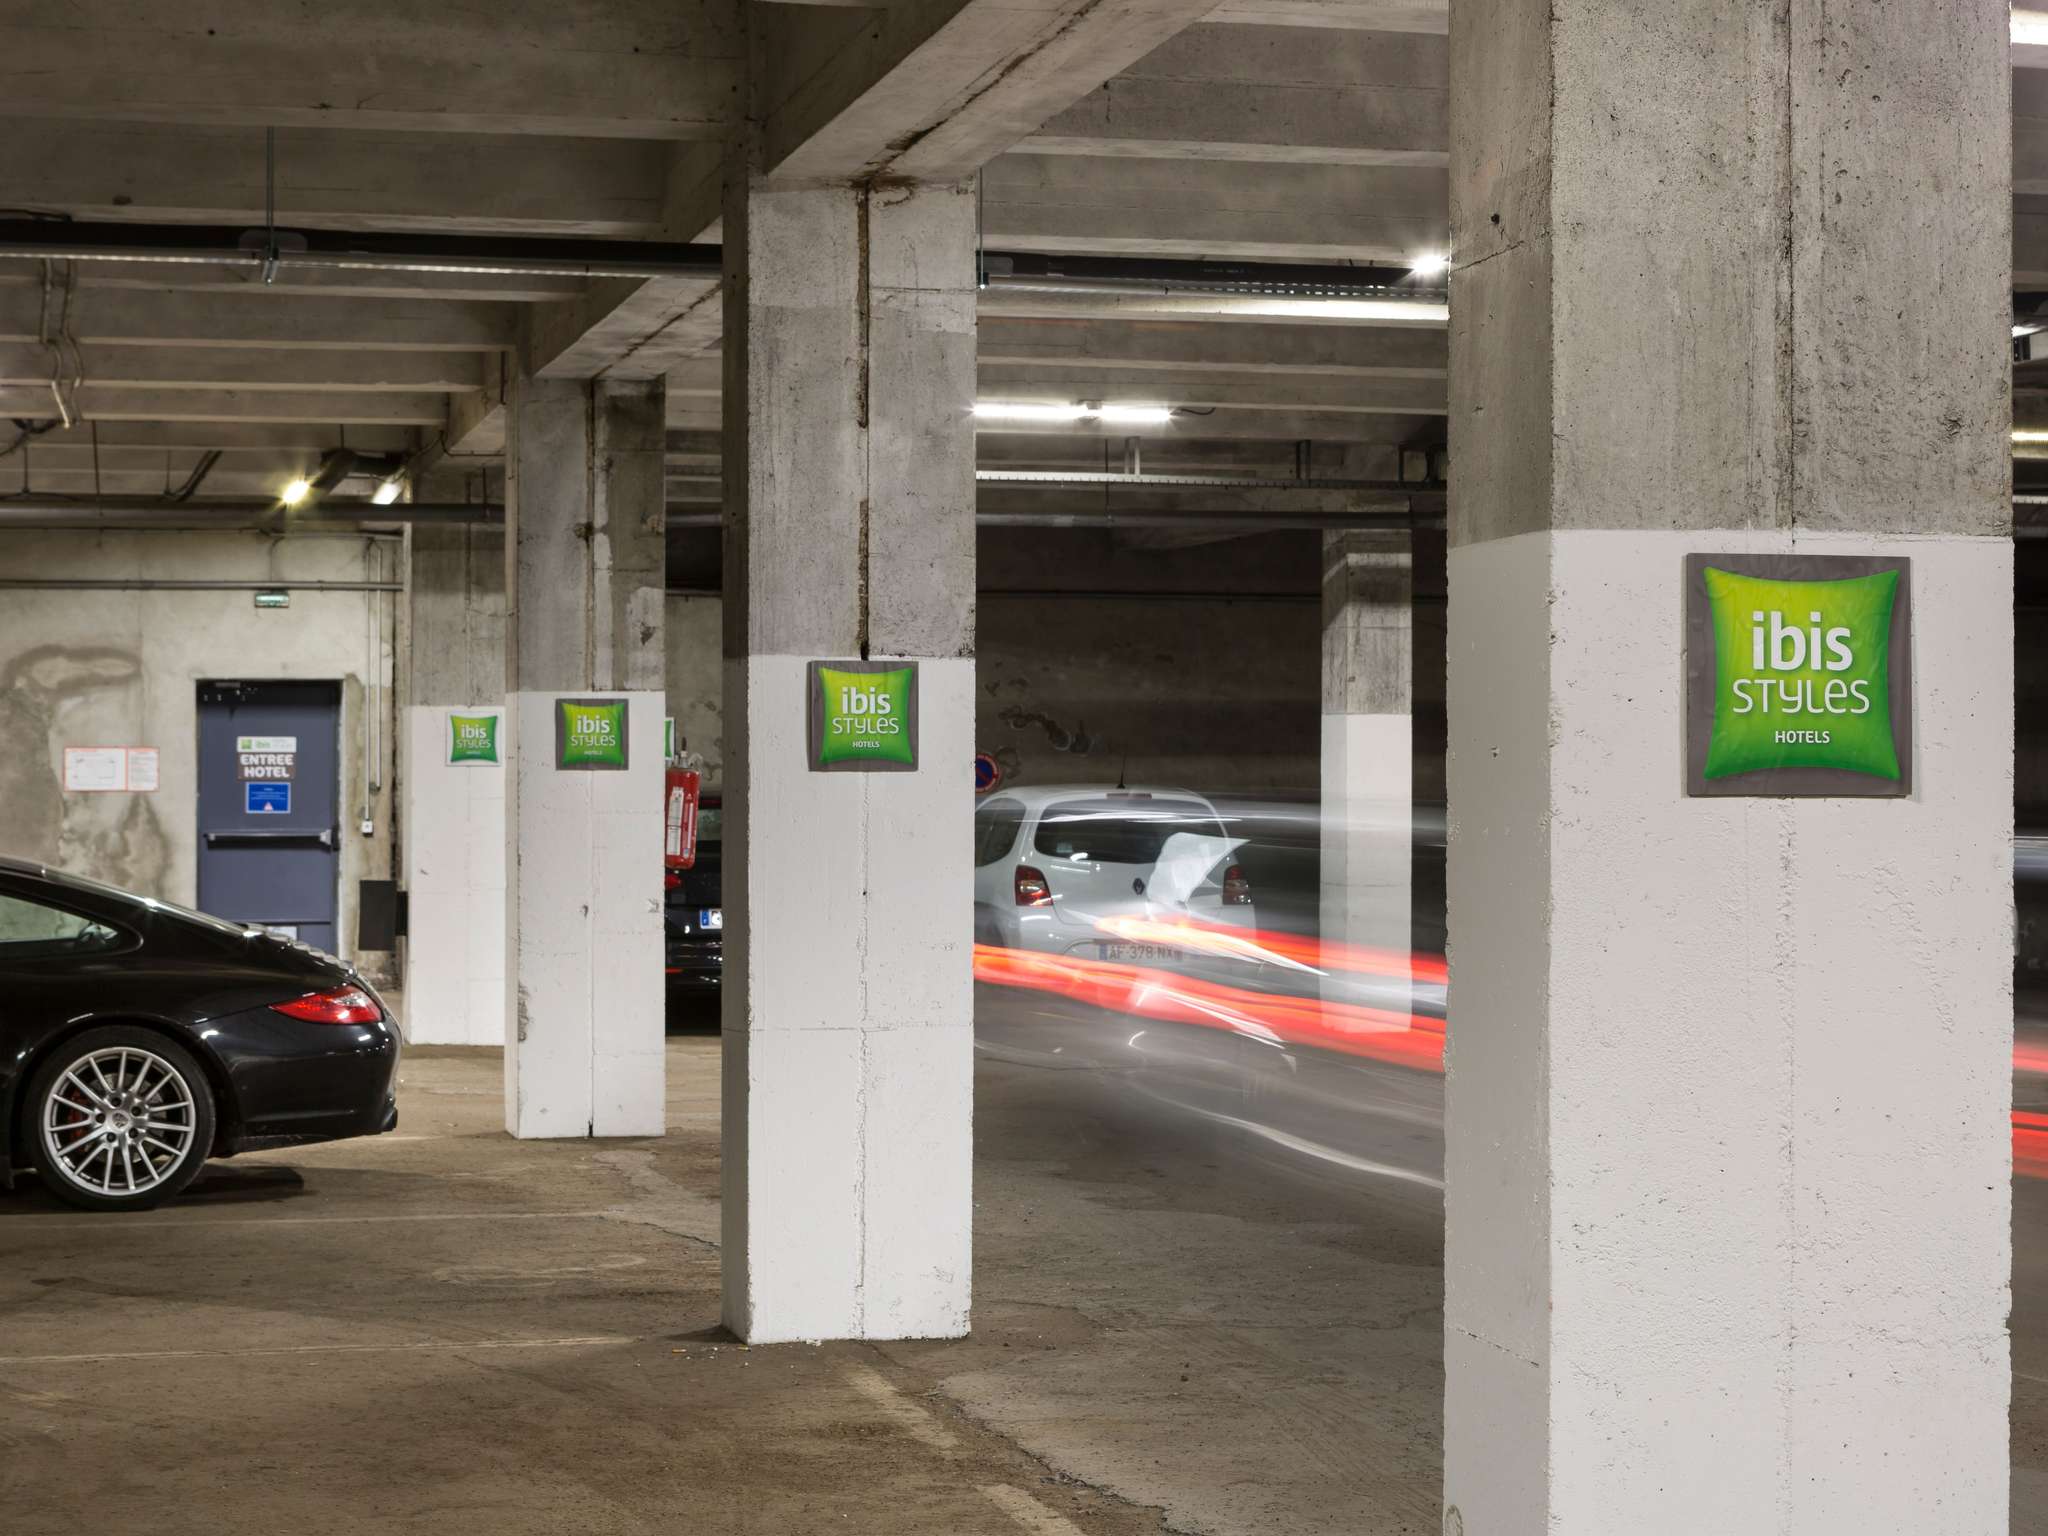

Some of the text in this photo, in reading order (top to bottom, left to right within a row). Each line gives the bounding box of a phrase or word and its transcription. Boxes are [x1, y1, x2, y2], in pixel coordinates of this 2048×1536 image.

[1752, 610, 1853, 671] ibis
[841, 686, 892, 715] ibis
[576, 714, 611, 734] ibis
[461, 724, 487, 739] ibis
[1774, 730, 1831, 744] HOTELS
[852, 740, 881, 749] HOTELS
[239, 753, 294, 766] ENTREE
[243, 765, 291, 778] HOTEL
